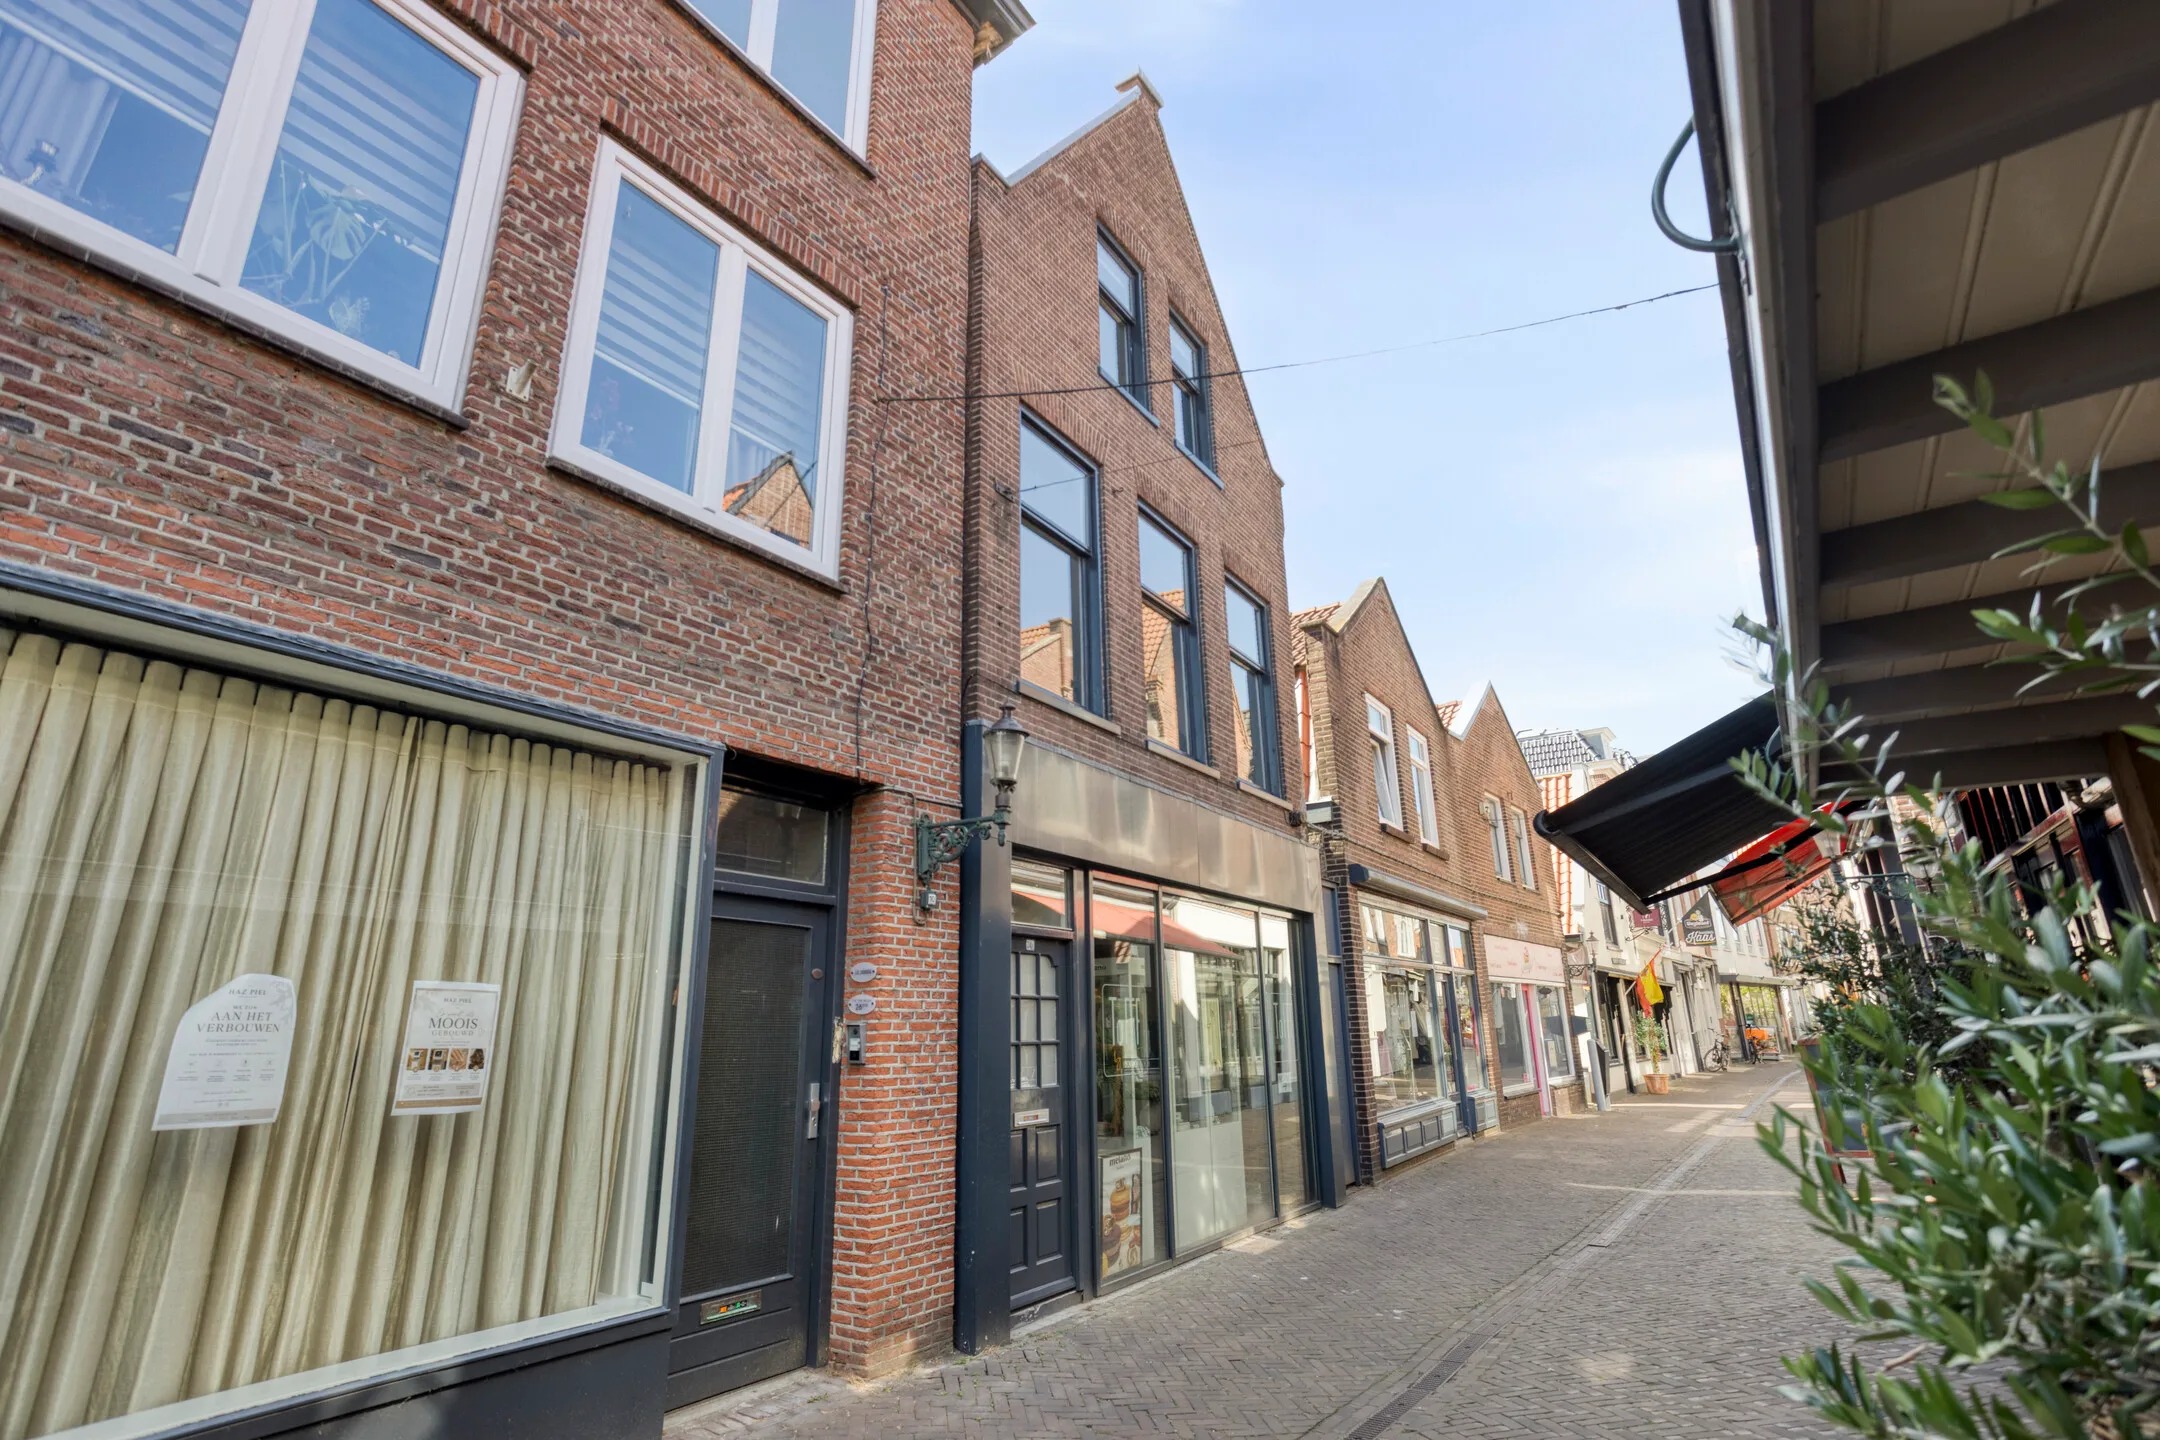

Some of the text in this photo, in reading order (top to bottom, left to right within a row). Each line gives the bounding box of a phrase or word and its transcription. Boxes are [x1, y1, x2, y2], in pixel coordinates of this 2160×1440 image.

[1685, 930, 1716, 945] Kaas
[211, 1011, 273, 1021] AAN HET
[197, 1023, 280, 1033] VERBOUWEN
[428, 1017, 479, 1029] MOOIS
